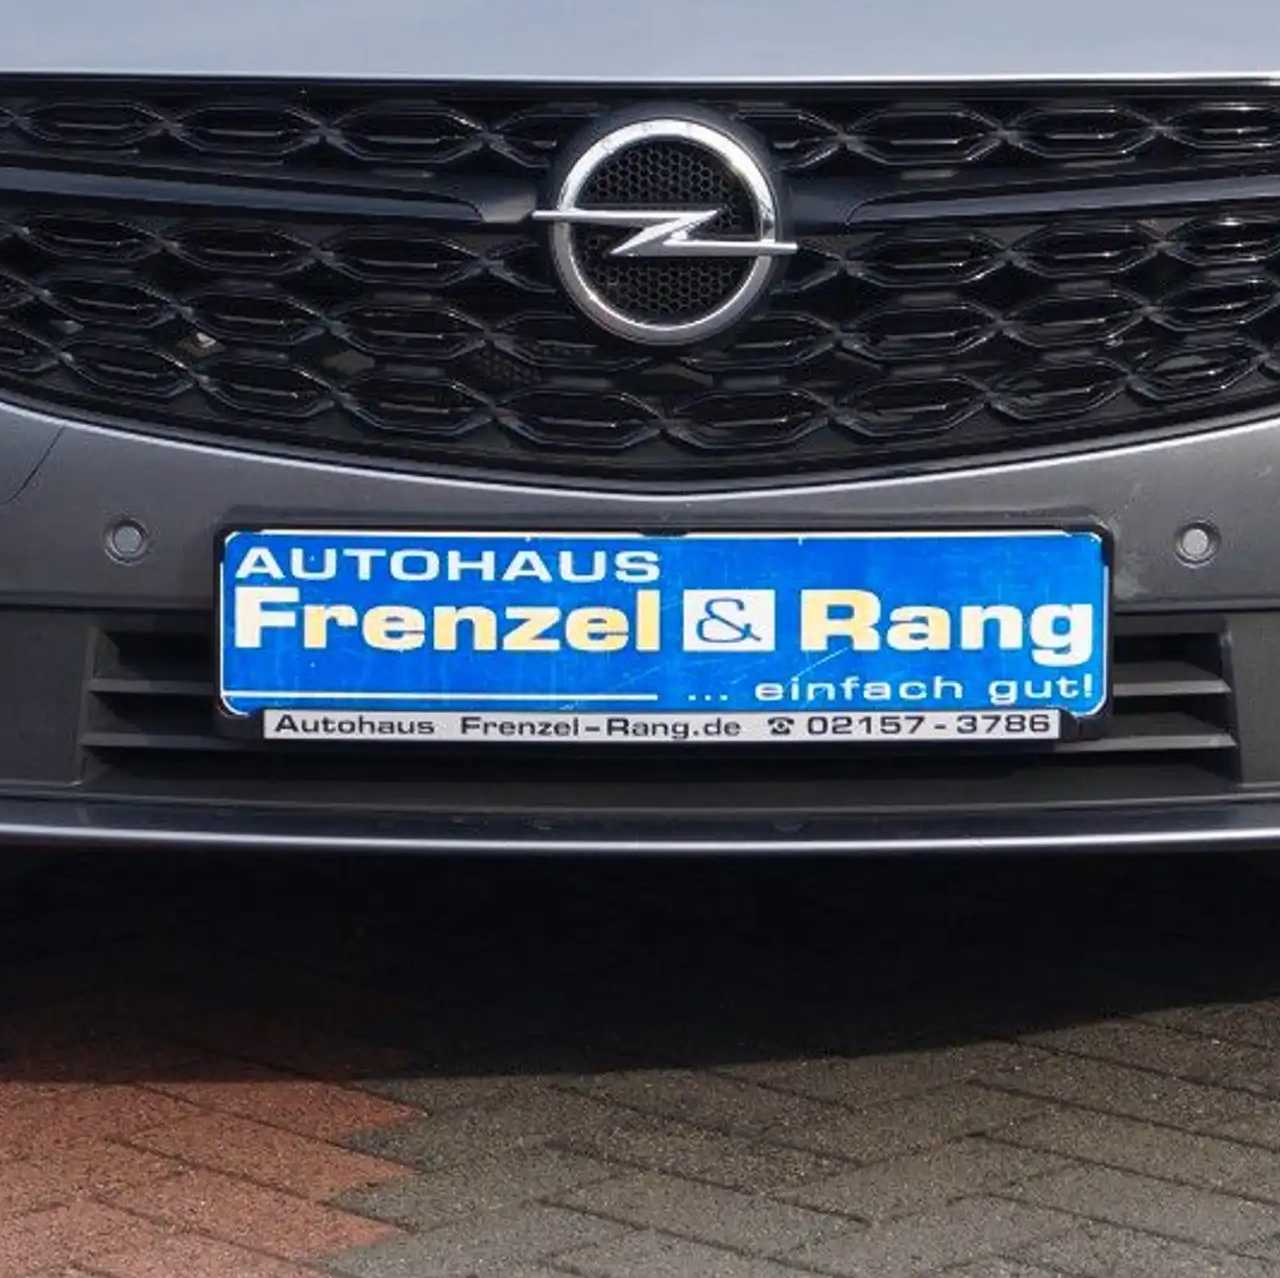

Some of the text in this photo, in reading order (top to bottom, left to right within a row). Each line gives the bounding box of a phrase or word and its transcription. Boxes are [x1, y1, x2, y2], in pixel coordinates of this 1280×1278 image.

[235, 546, 661, 583] AUTOHAUS
[234, 585, 1094, 667] Frenzel & Rang
[754, 676, 964, 702] einfach
[989, 673, 1094, 706] gut!
[275, 714, 435, 736] Autohaus
[807, 714, 1052, 735] 02157-3786
